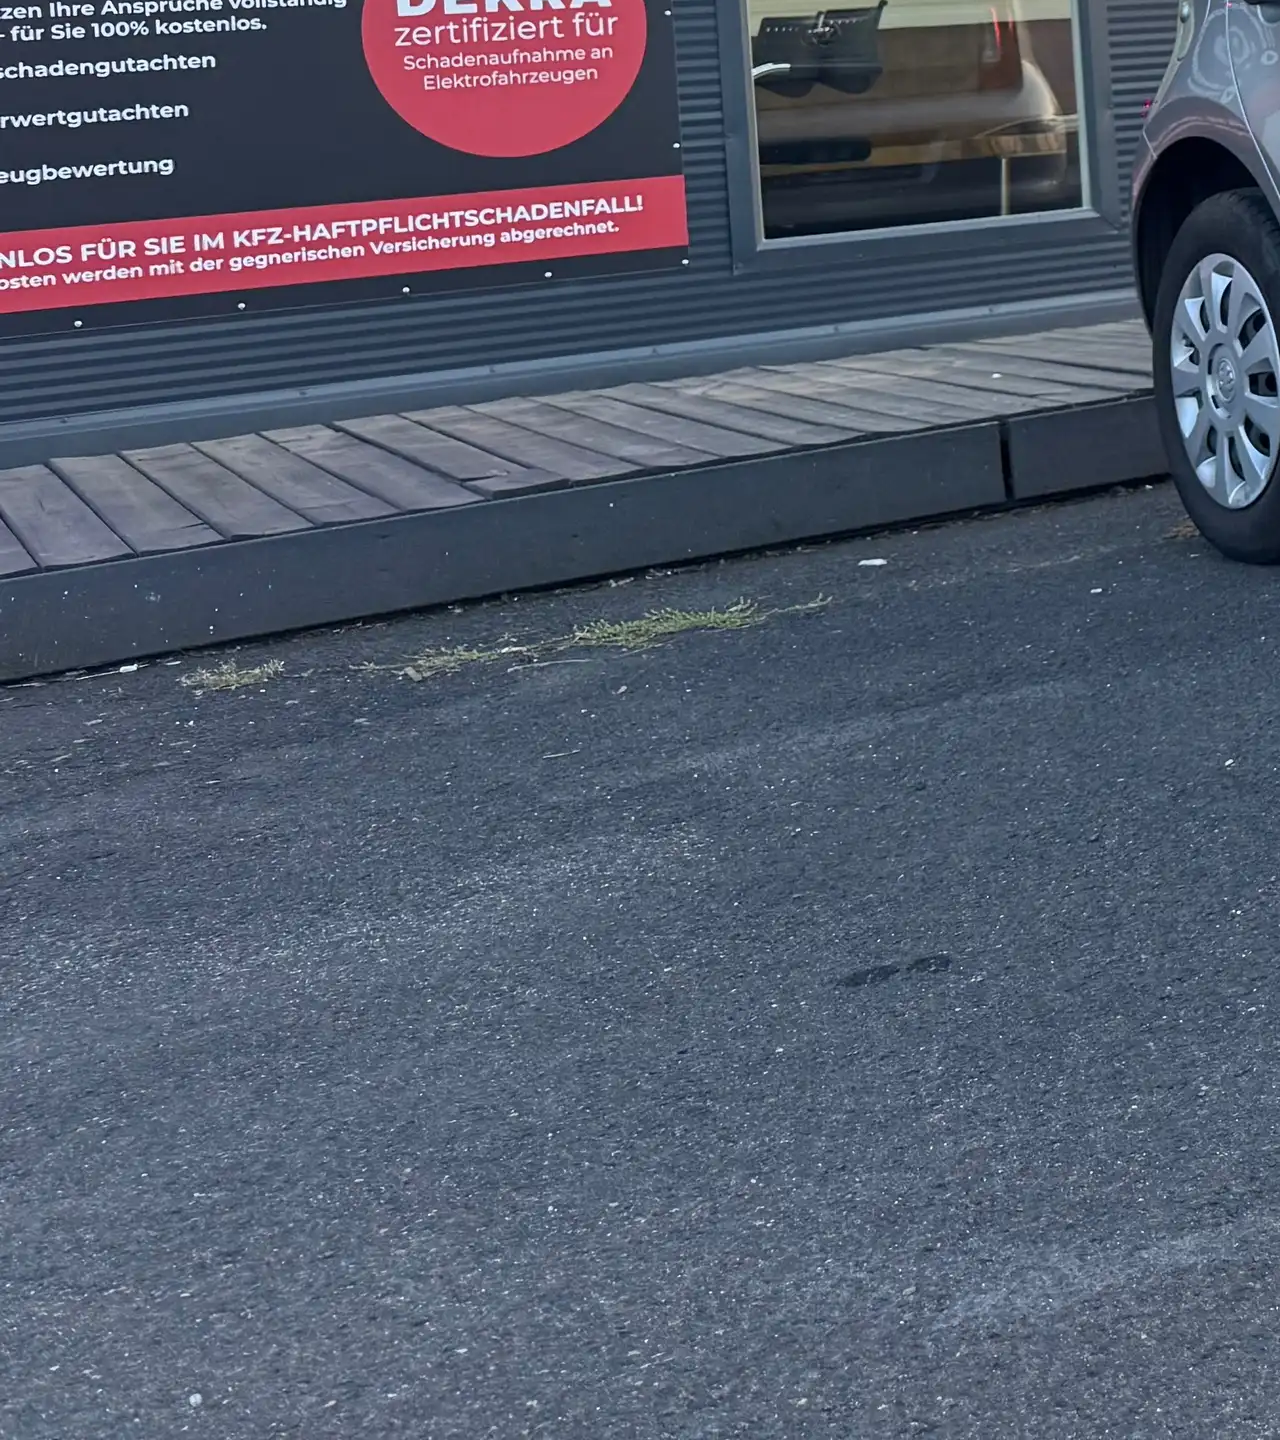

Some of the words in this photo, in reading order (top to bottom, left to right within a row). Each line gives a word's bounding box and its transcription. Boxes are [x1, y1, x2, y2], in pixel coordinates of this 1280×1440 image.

[50, 2, 94, 17] Ihre
[10, 26, 44, 41] für
[51, 23, 85, 39] Sie
[91, 21, 149, 37] 100%
[156, 16, 266, 34] kostenlos.
[395, 16, 564, 46] zertifiziert
[572, 12, 618, 36] für
[404, 48, 585, 70] Schadenaufnahme
[591, 47, 612, 59] an
[424, 69, 597, 90] Elektrofahrzeugen
[81, 238, 136, 261] FÜR
[144, 236, 185, 255] SIE
[194, 232, 224, 251] IM
[233, 195, 643, 248] KFZ-HAFTPFLICHTSCHADENFALL!
[62, 266, 142, 284] werden
[149, 260, 184, 276] mit
[190, 257, 224, 271] der
[229, 246, 364, 271] gegnerischen
[370, 232, 495, 258] Versicherung
[500, 221, 619, 246] abgerechnet.
